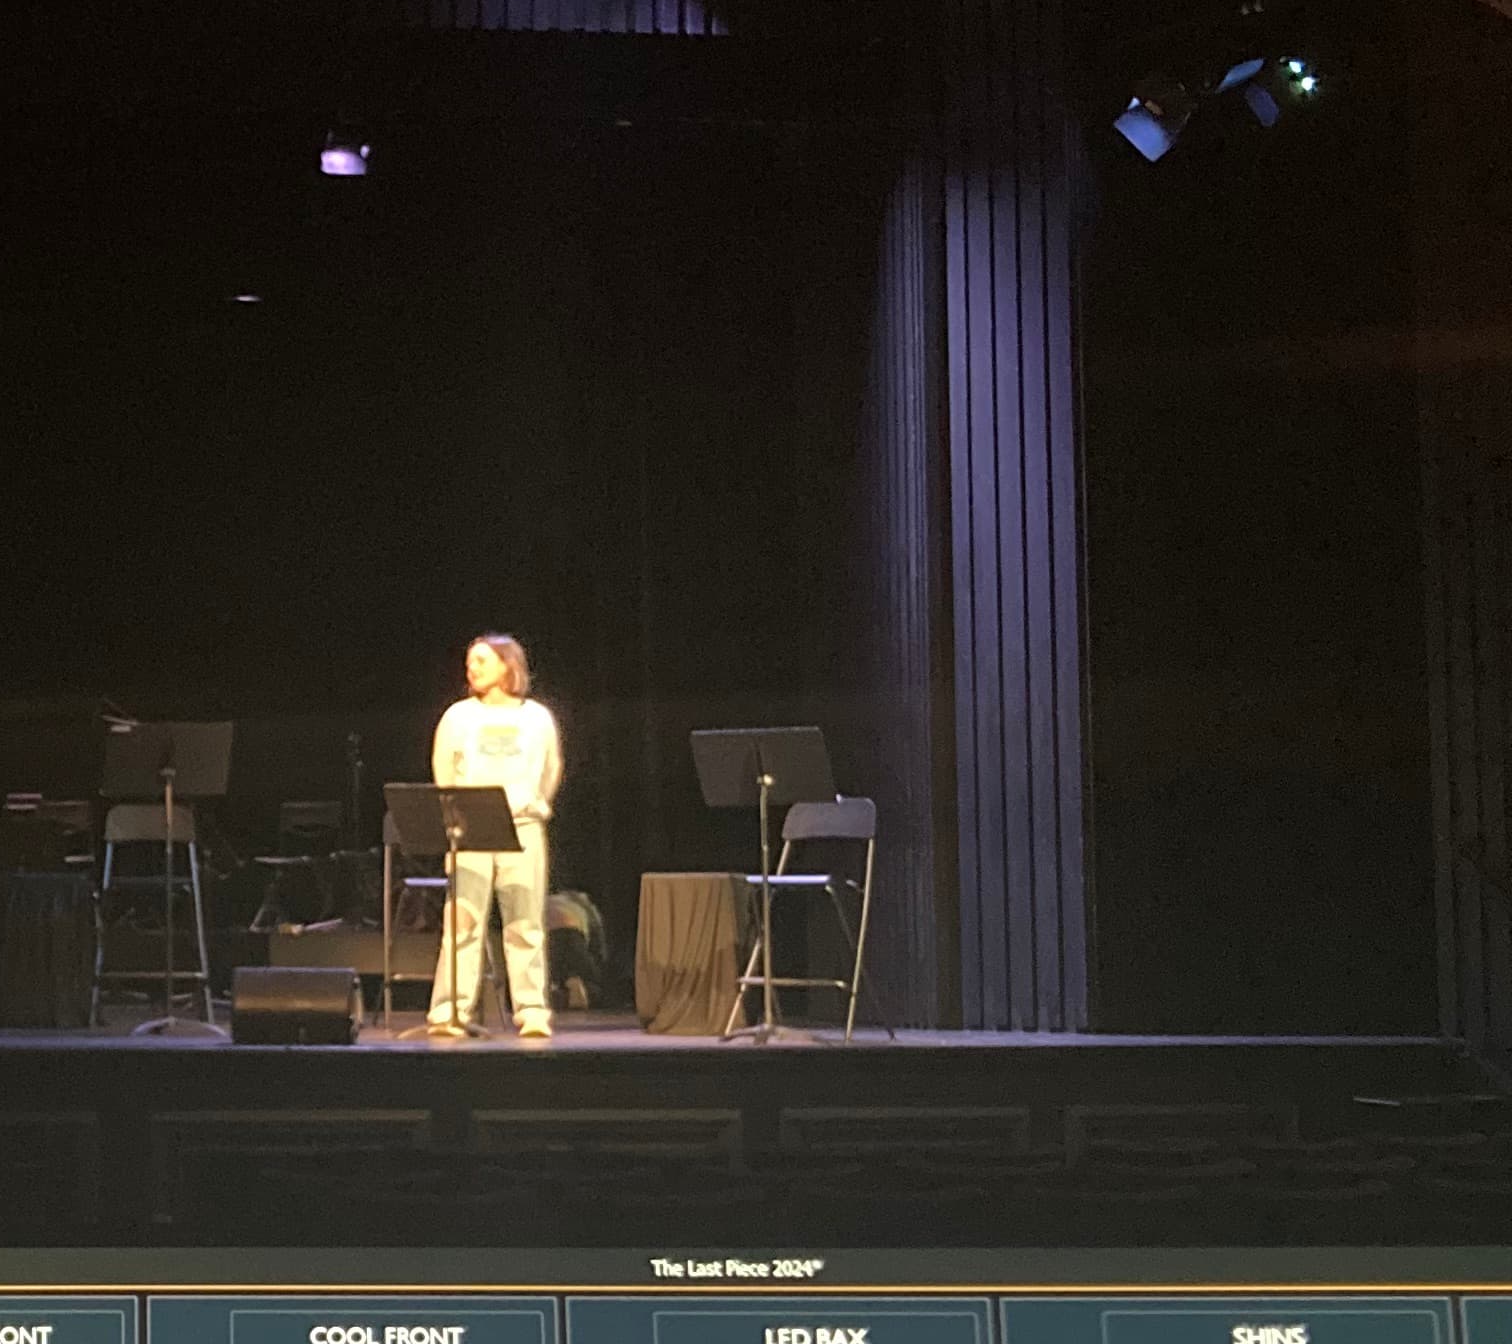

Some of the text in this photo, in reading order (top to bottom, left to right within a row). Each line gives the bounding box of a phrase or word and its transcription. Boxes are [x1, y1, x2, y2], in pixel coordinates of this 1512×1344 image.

[651, 1259, 684, 1277] The
[688, 1260, 723, 1277] Last
[726, 1260, 770, 1277] Piece
